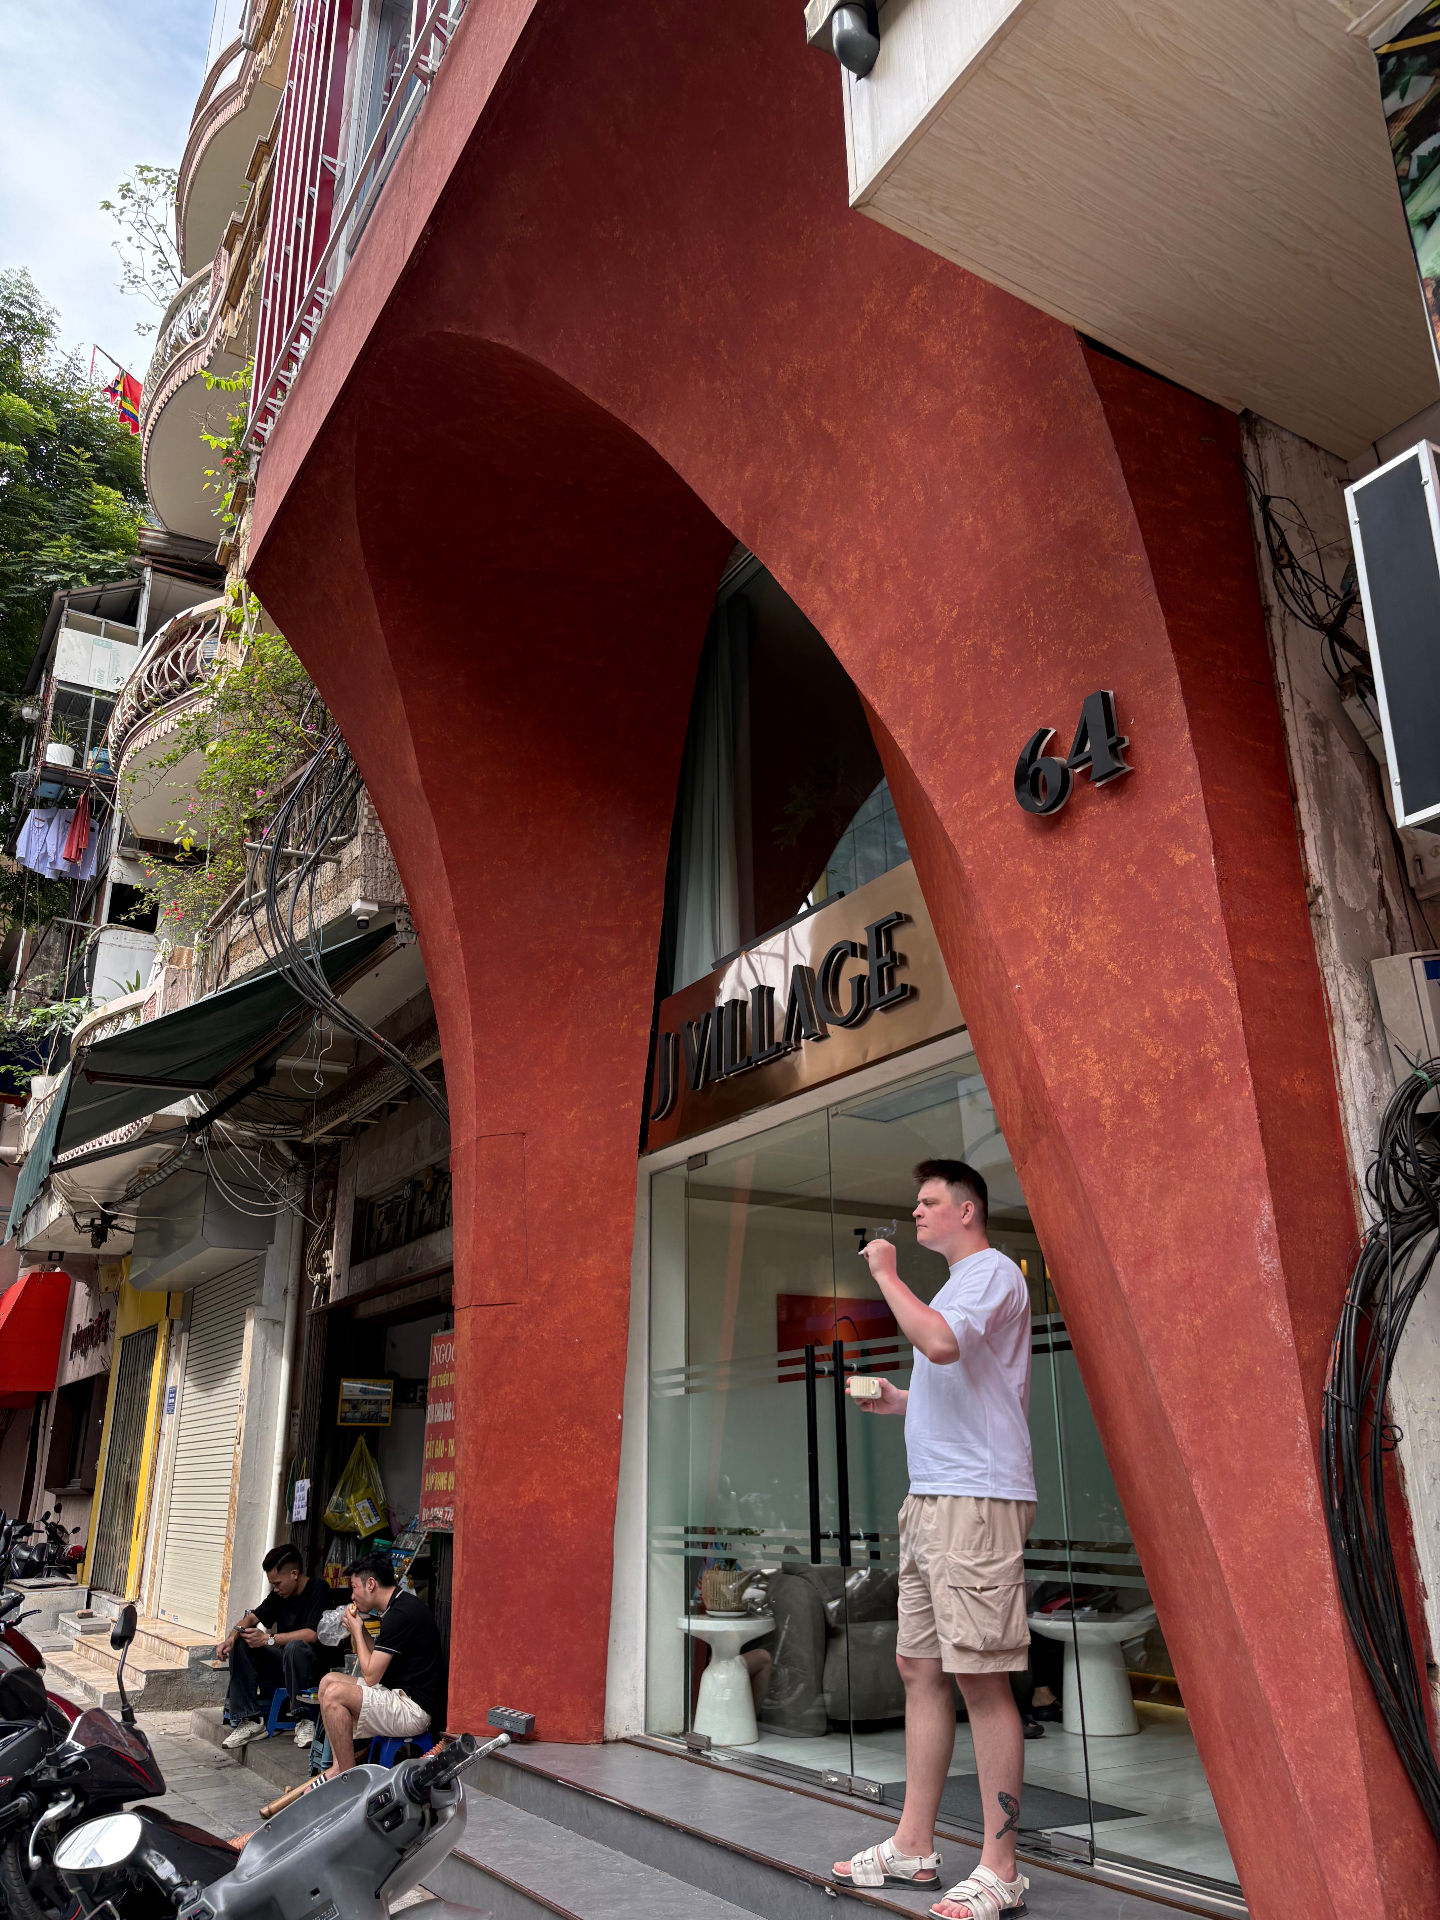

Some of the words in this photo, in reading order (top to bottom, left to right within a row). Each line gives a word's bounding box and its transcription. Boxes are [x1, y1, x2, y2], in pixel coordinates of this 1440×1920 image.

[1014, 690, 1132, 816] 64
[650, 1032, 679, 1121] J
[680, 911, 911, 1090] VILLAGE
